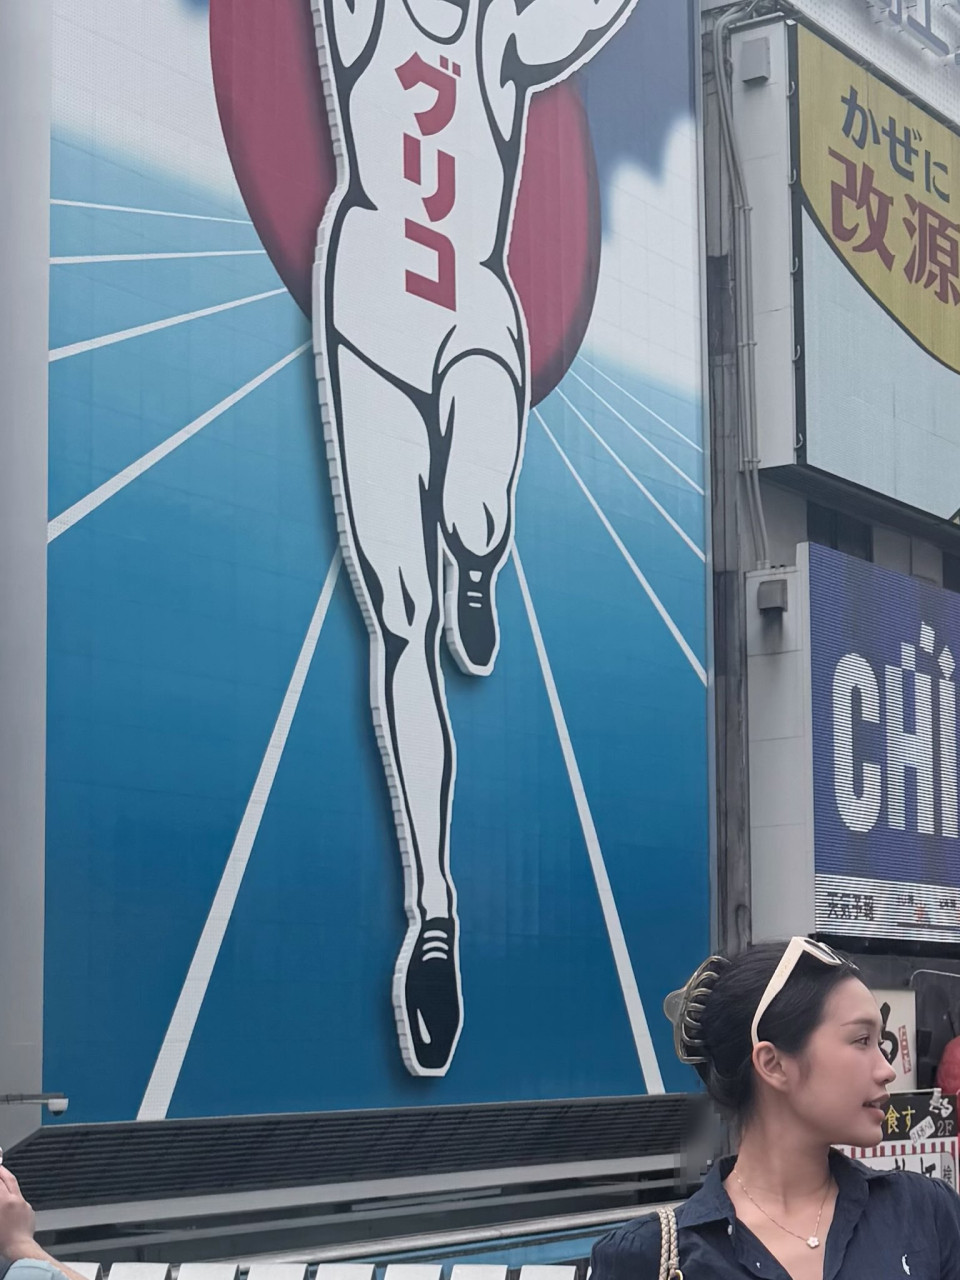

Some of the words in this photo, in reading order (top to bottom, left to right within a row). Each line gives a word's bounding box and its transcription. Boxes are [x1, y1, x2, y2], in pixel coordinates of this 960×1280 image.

[394, 51, 461, 312] グリコ
[841, 85, 950, 203] かぜに
[937, 1120, 954, 1136] 2F
